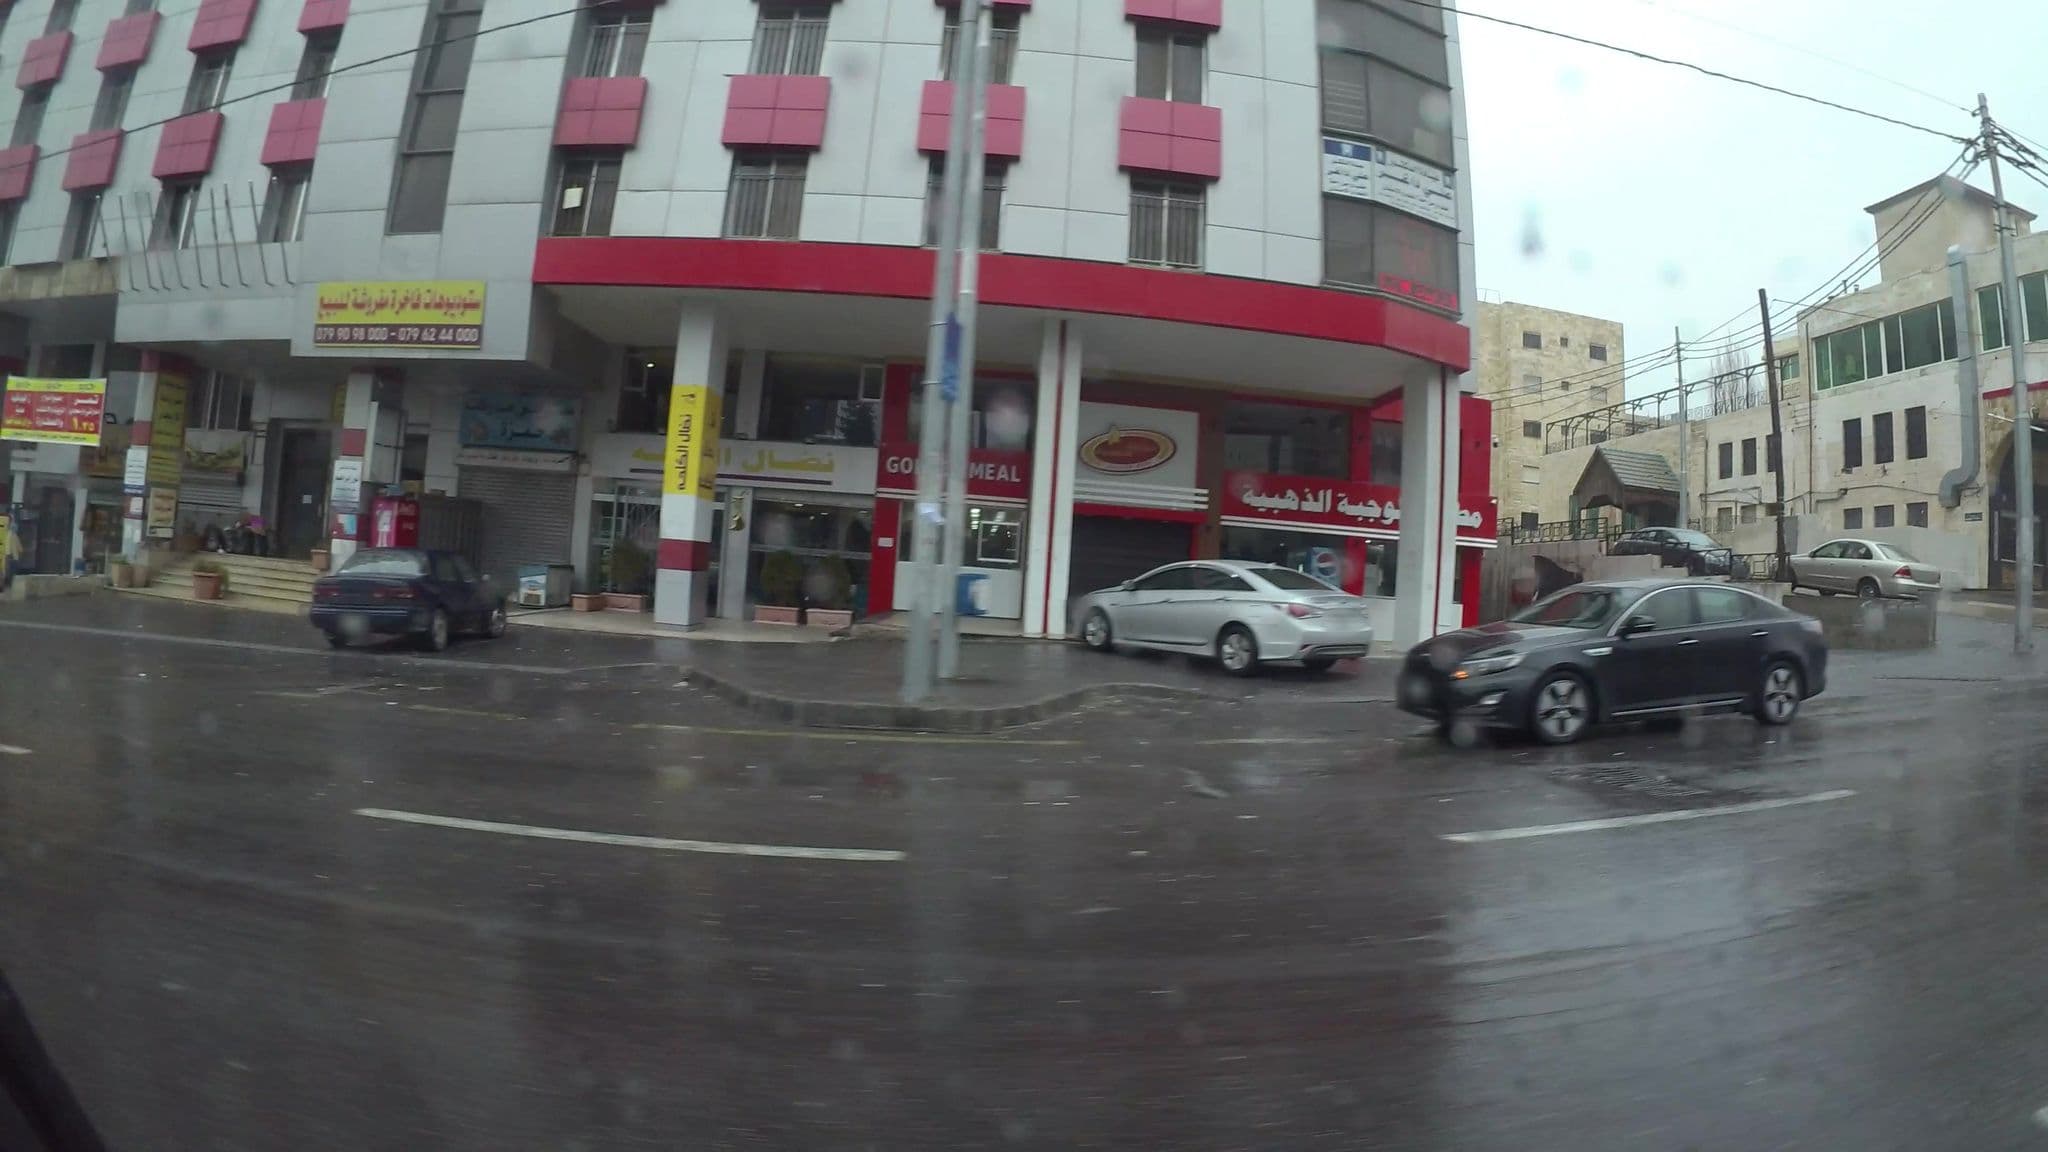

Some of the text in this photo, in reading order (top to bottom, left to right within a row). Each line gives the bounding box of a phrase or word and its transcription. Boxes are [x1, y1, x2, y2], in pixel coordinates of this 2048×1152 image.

[398, 328, 419, 341] 079
[456, 328, 479, 342] 000
[968, 461, 1022, 483] MEAL
[1242, 488, 1332, 515] الذهبية
